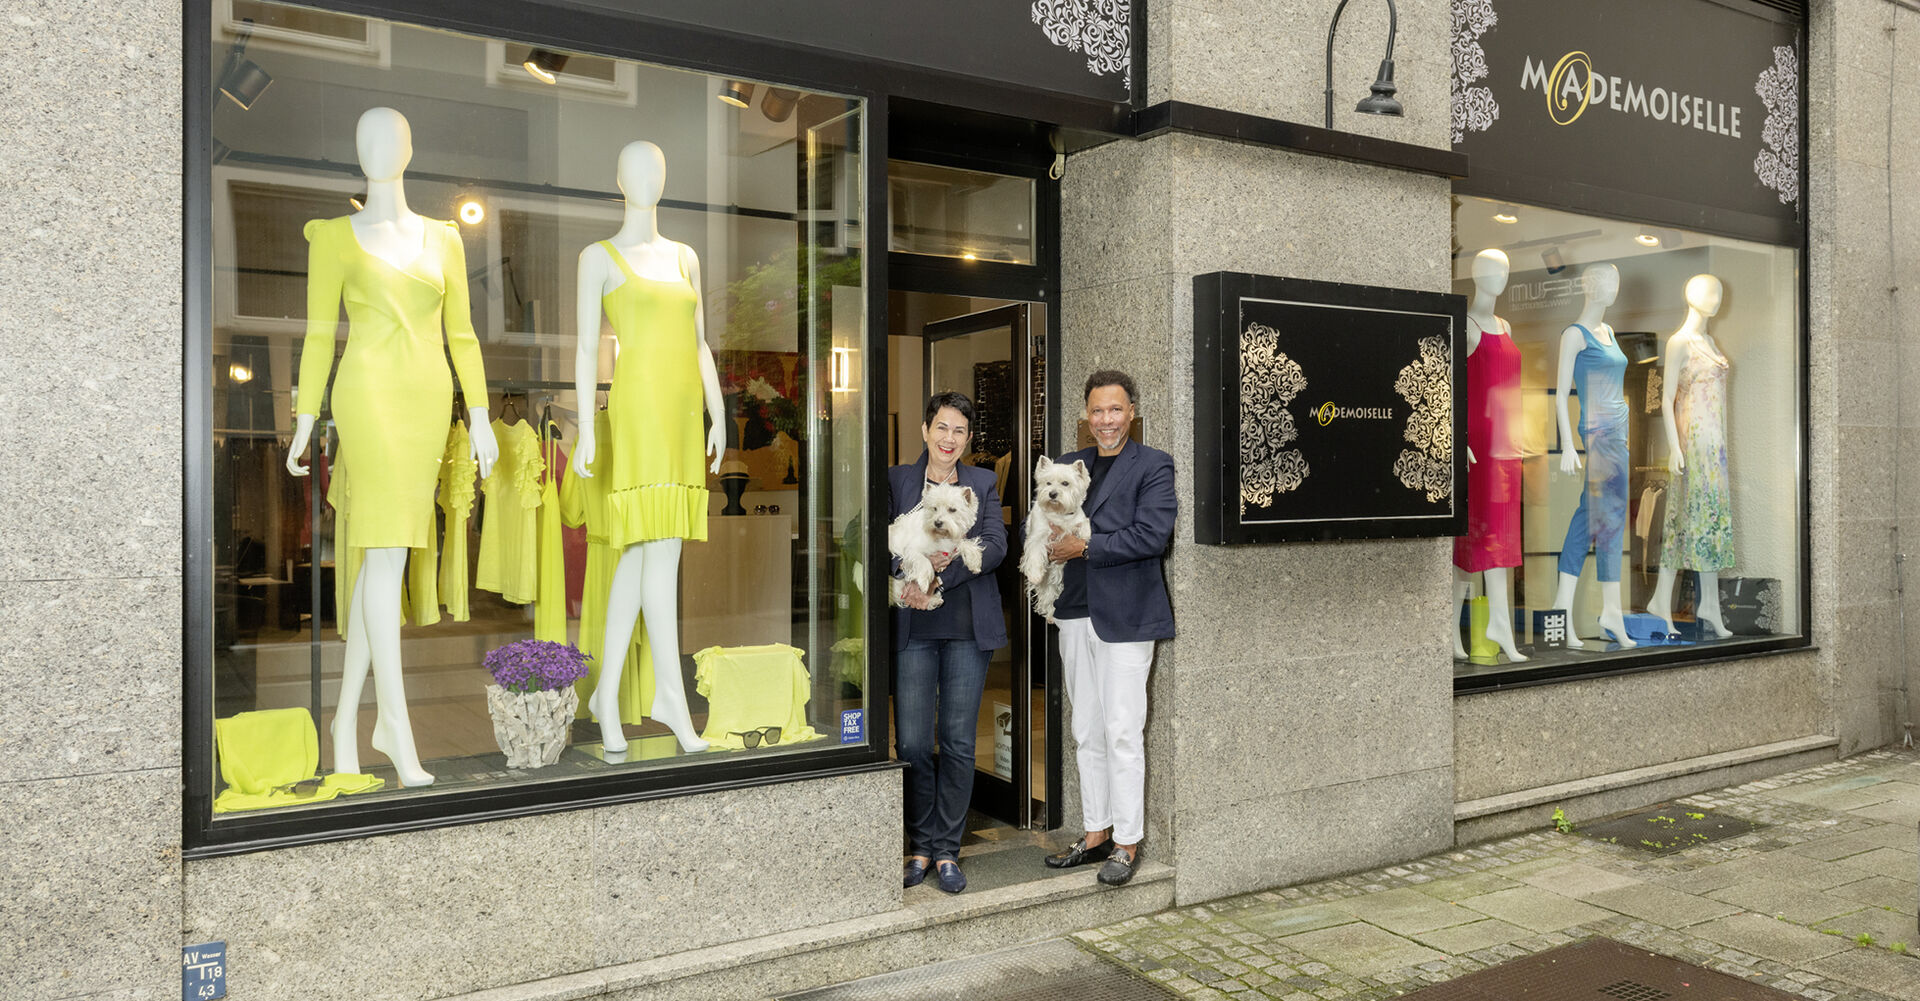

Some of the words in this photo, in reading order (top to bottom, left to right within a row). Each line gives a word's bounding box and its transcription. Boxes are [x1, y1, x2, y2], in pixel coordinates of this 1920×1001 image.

[1520, 51, 1741, 138] MADEMOISELLE
[1309, 403, 1393, 424] MADEMOISELLE
[843, 711, 862, 720] SHOP
[843, 719, 857, 727] TAX
[843, 726, 860, 734] FREE
[183, 951, 199, 966] AV
